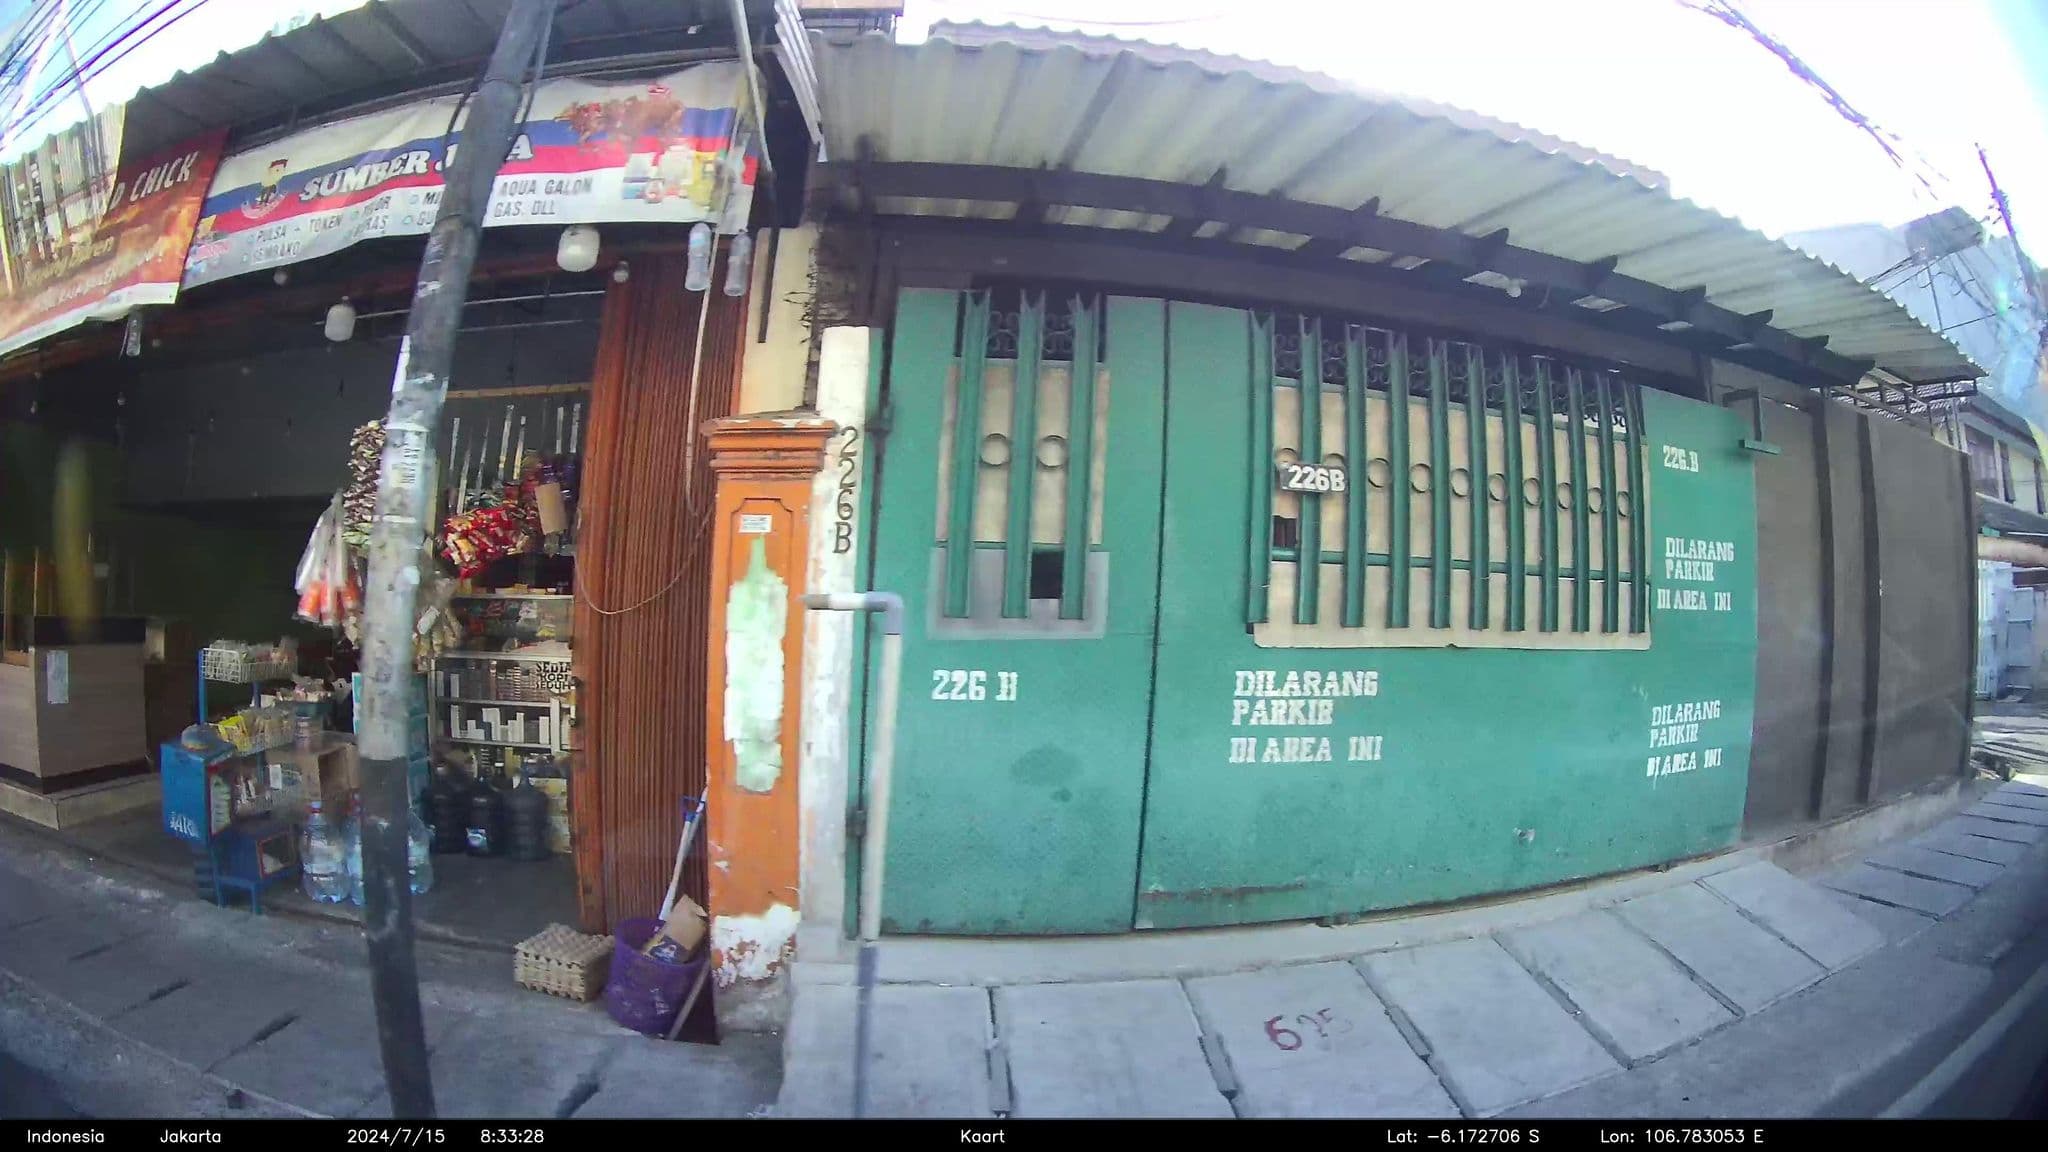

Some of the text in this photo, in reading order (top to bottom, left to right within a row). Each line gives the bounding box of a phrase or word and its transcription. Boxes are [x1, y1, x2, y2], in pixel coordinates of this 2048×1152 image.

[130, 150, 200, 202] CHICK
[299, 134, 534, 201] SUMBER JA
[500, 177, 593, 198] AQUA GALON
[531, 199, 556, 215] DLL
[833, 426, 858, 554] 226B
[1288, 465, 1345, 491] 226B
[1665, 537, 1735, 562] DILARANG
[1665, 558, 1715, 582] PARKIR
[1657, 588, 1731, 611] DI AREA INI
[535, 680, 571, 690] SEDUH
[540, 673, 568, 681] KOPI
[931, 669, 986, 701] 226
[1234, 670, 1378, 697] DILARANG
[1232, 699, 1334, 725] PARKIR
[1652, 699, 1721, 727] DILARANG
[1650, 723, 1699, 748] PARKIR
[1229, 735, 1383, 763] DI AREA INI
[1661, 751, 1697, 776] AREA
[1704, 747, 1722, 769] INI
